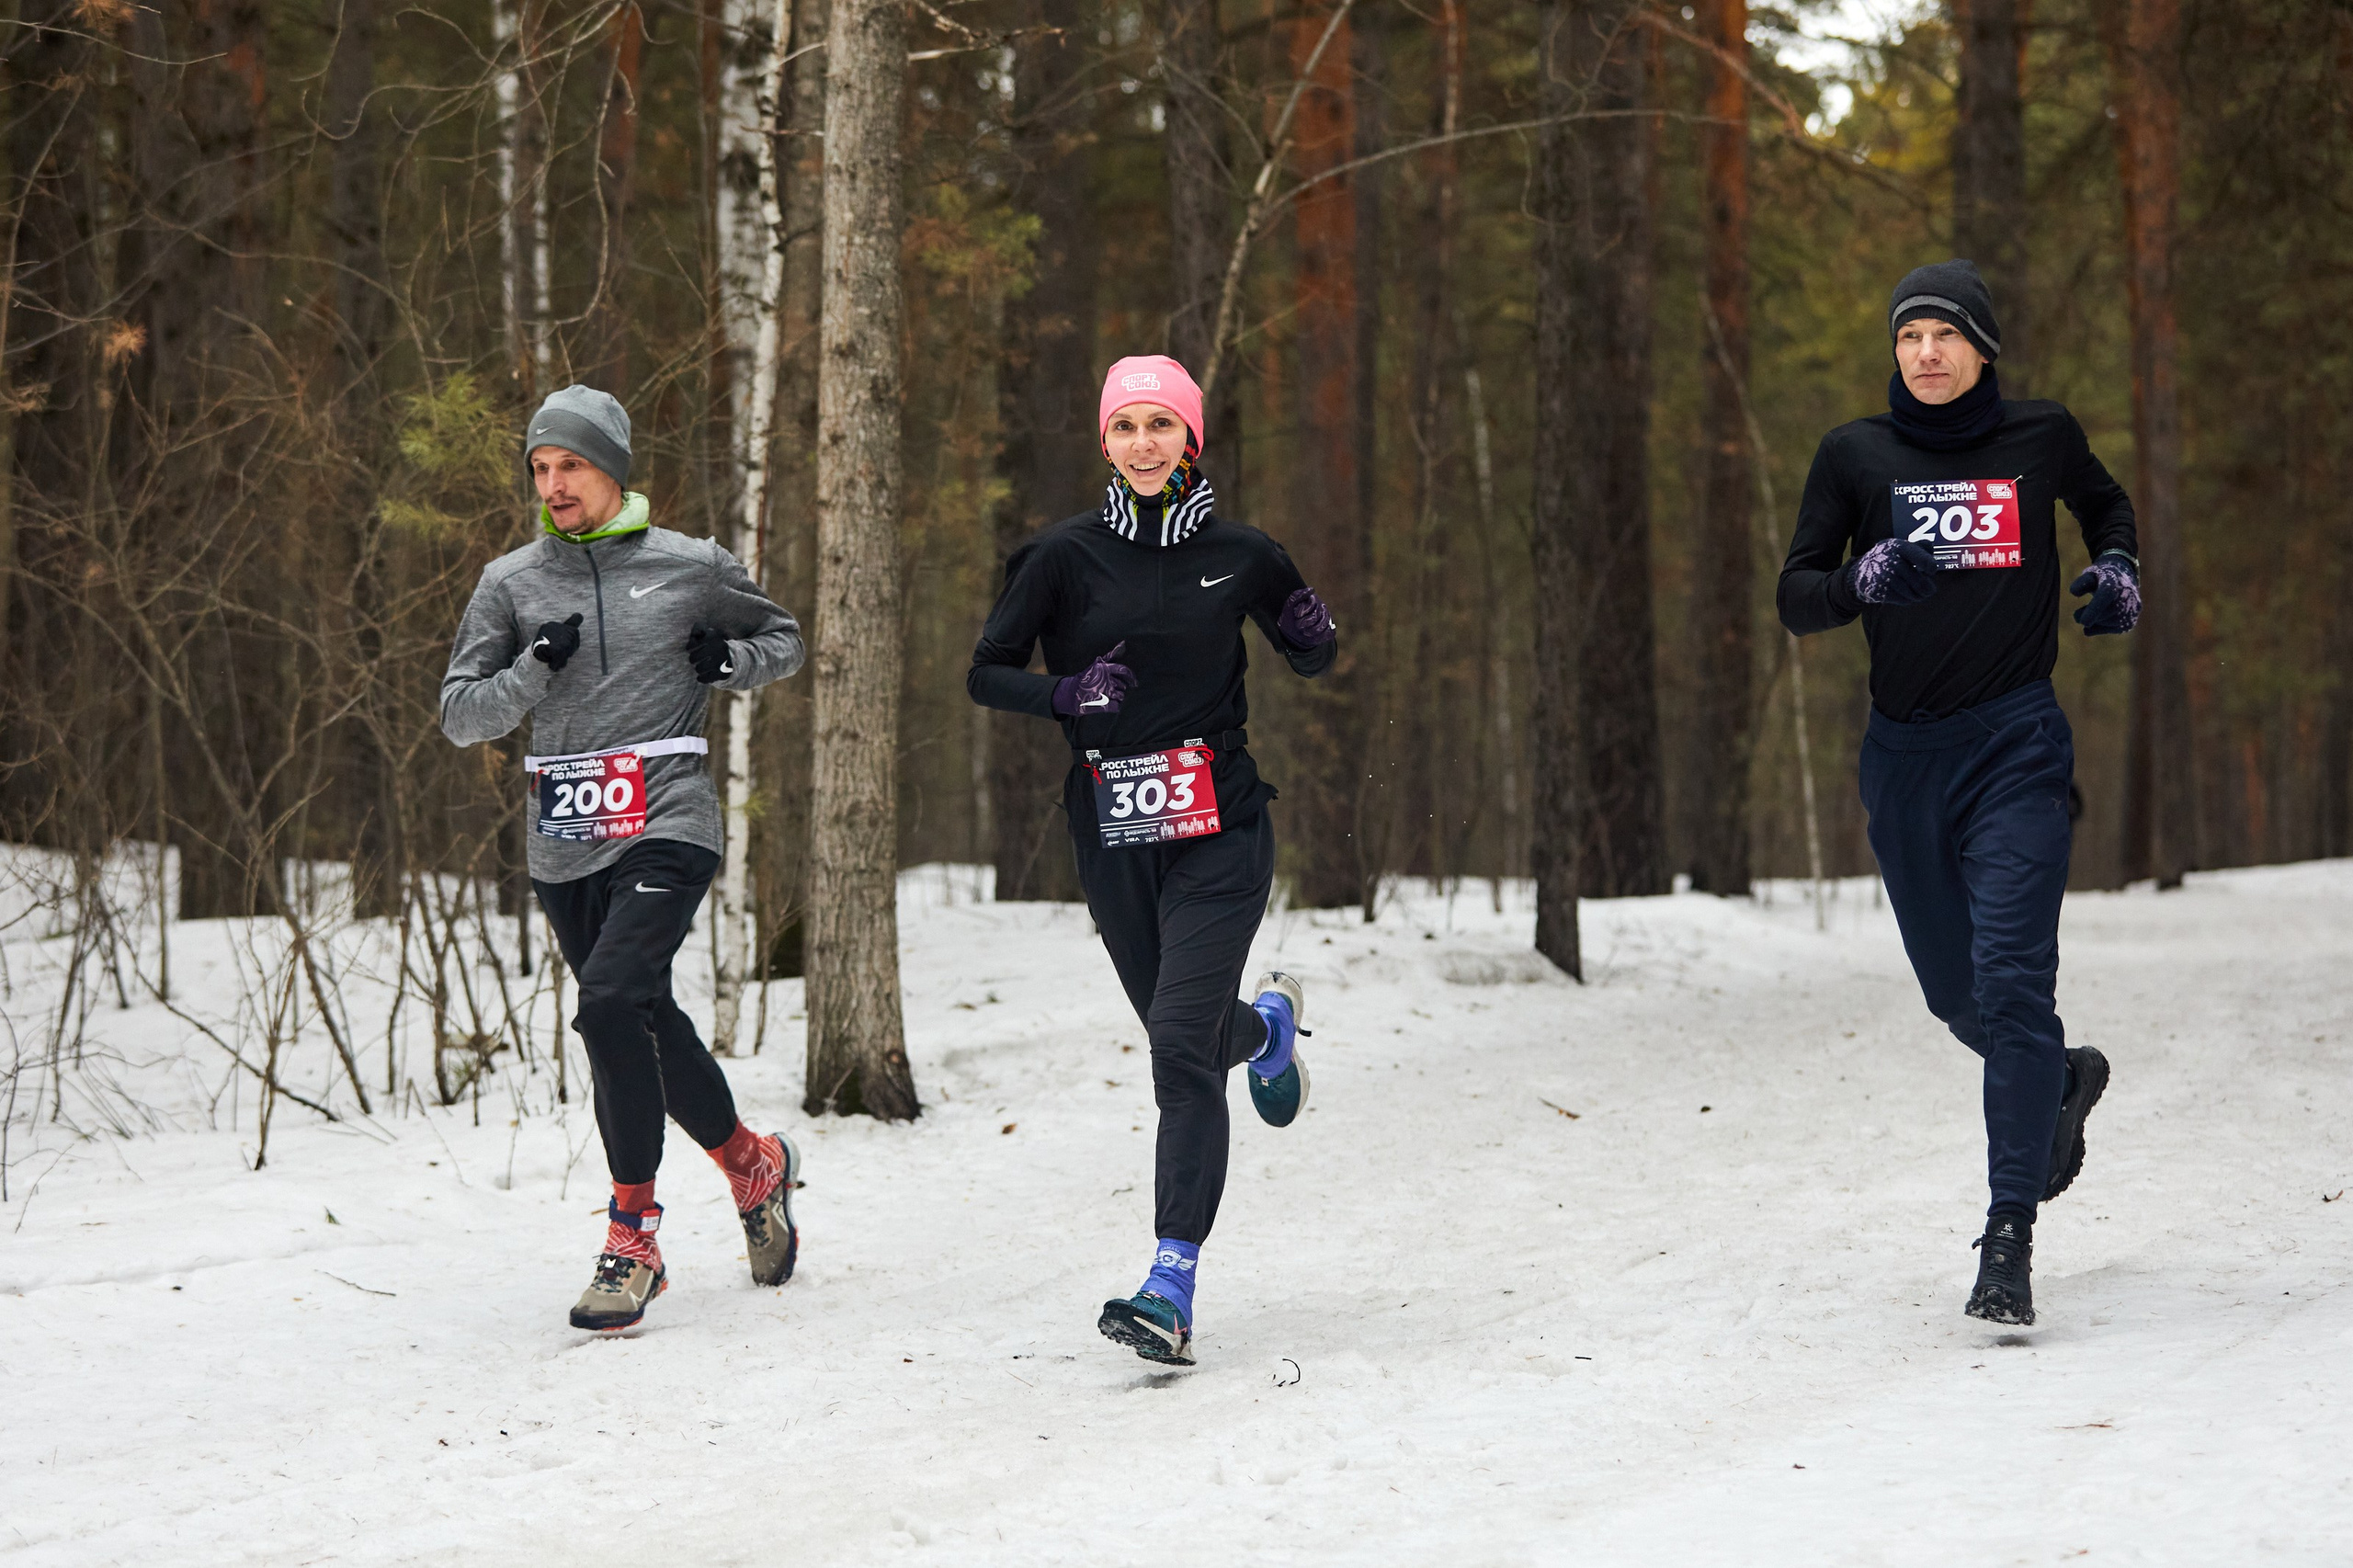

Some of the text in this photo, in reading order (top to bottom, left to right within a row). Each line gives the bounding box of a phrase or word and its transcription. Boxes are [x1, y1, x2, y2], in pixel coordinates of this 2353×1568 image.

[1128, 381, 1158, 390] СОЮЗ
[1894, 482, 1978, 494] КРОСС ТРЕЙЛ
[1908, 493, 1978, 504] ПО ЛЫЖНЕ
[1907, 505, 2003, 543] 203
[571, 758, 606, 768] ТРЕЙЛ
[1100, 754, 1168, 771] РОСС ТРЕЙЛ
[1180, 753, 1199, 761] СПОР
[551, 767, 606, 780] ПО ЛЫЖНЕ
[1107, 764, 1169, 779] ПО ЛЫЖНЕ
[551, 778, 633, 818] 200
[1109, 772, 1196, 819] 303
